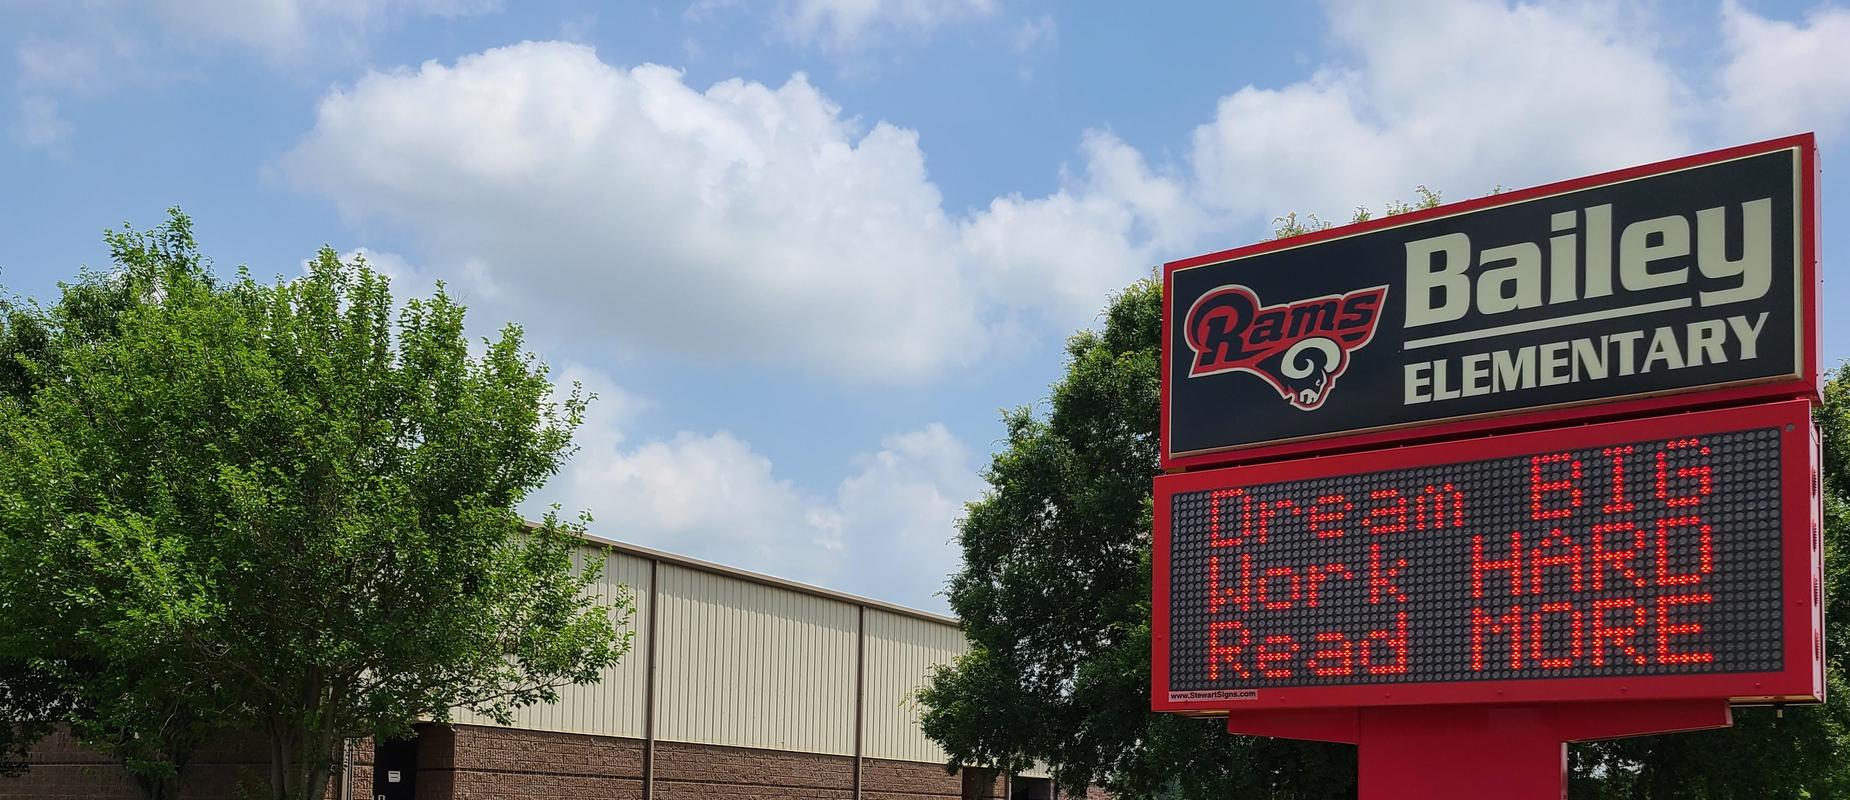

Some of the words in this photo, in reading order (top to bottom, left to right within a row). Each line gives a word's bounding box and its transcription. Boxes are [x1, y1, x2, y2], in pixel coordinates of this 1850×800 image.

[1404, 197, 1773, 328] Bailey
[1190, 290, 1380, 367] Rams
[1404, 311, 1769, 405] ELEMENTARY
[1210, 483, 1464, 548] Dream
[1531, 438, 1712, 520] BIG
[1209, 542, 1408, 614] Work
[1470, 515, 1713, 598] HARD
[1209, 611, 1408, 680] Read
[1470, 592, 1713, 671] MORE
[1170, 690, 1256, 699] www.StewartSigns.com
